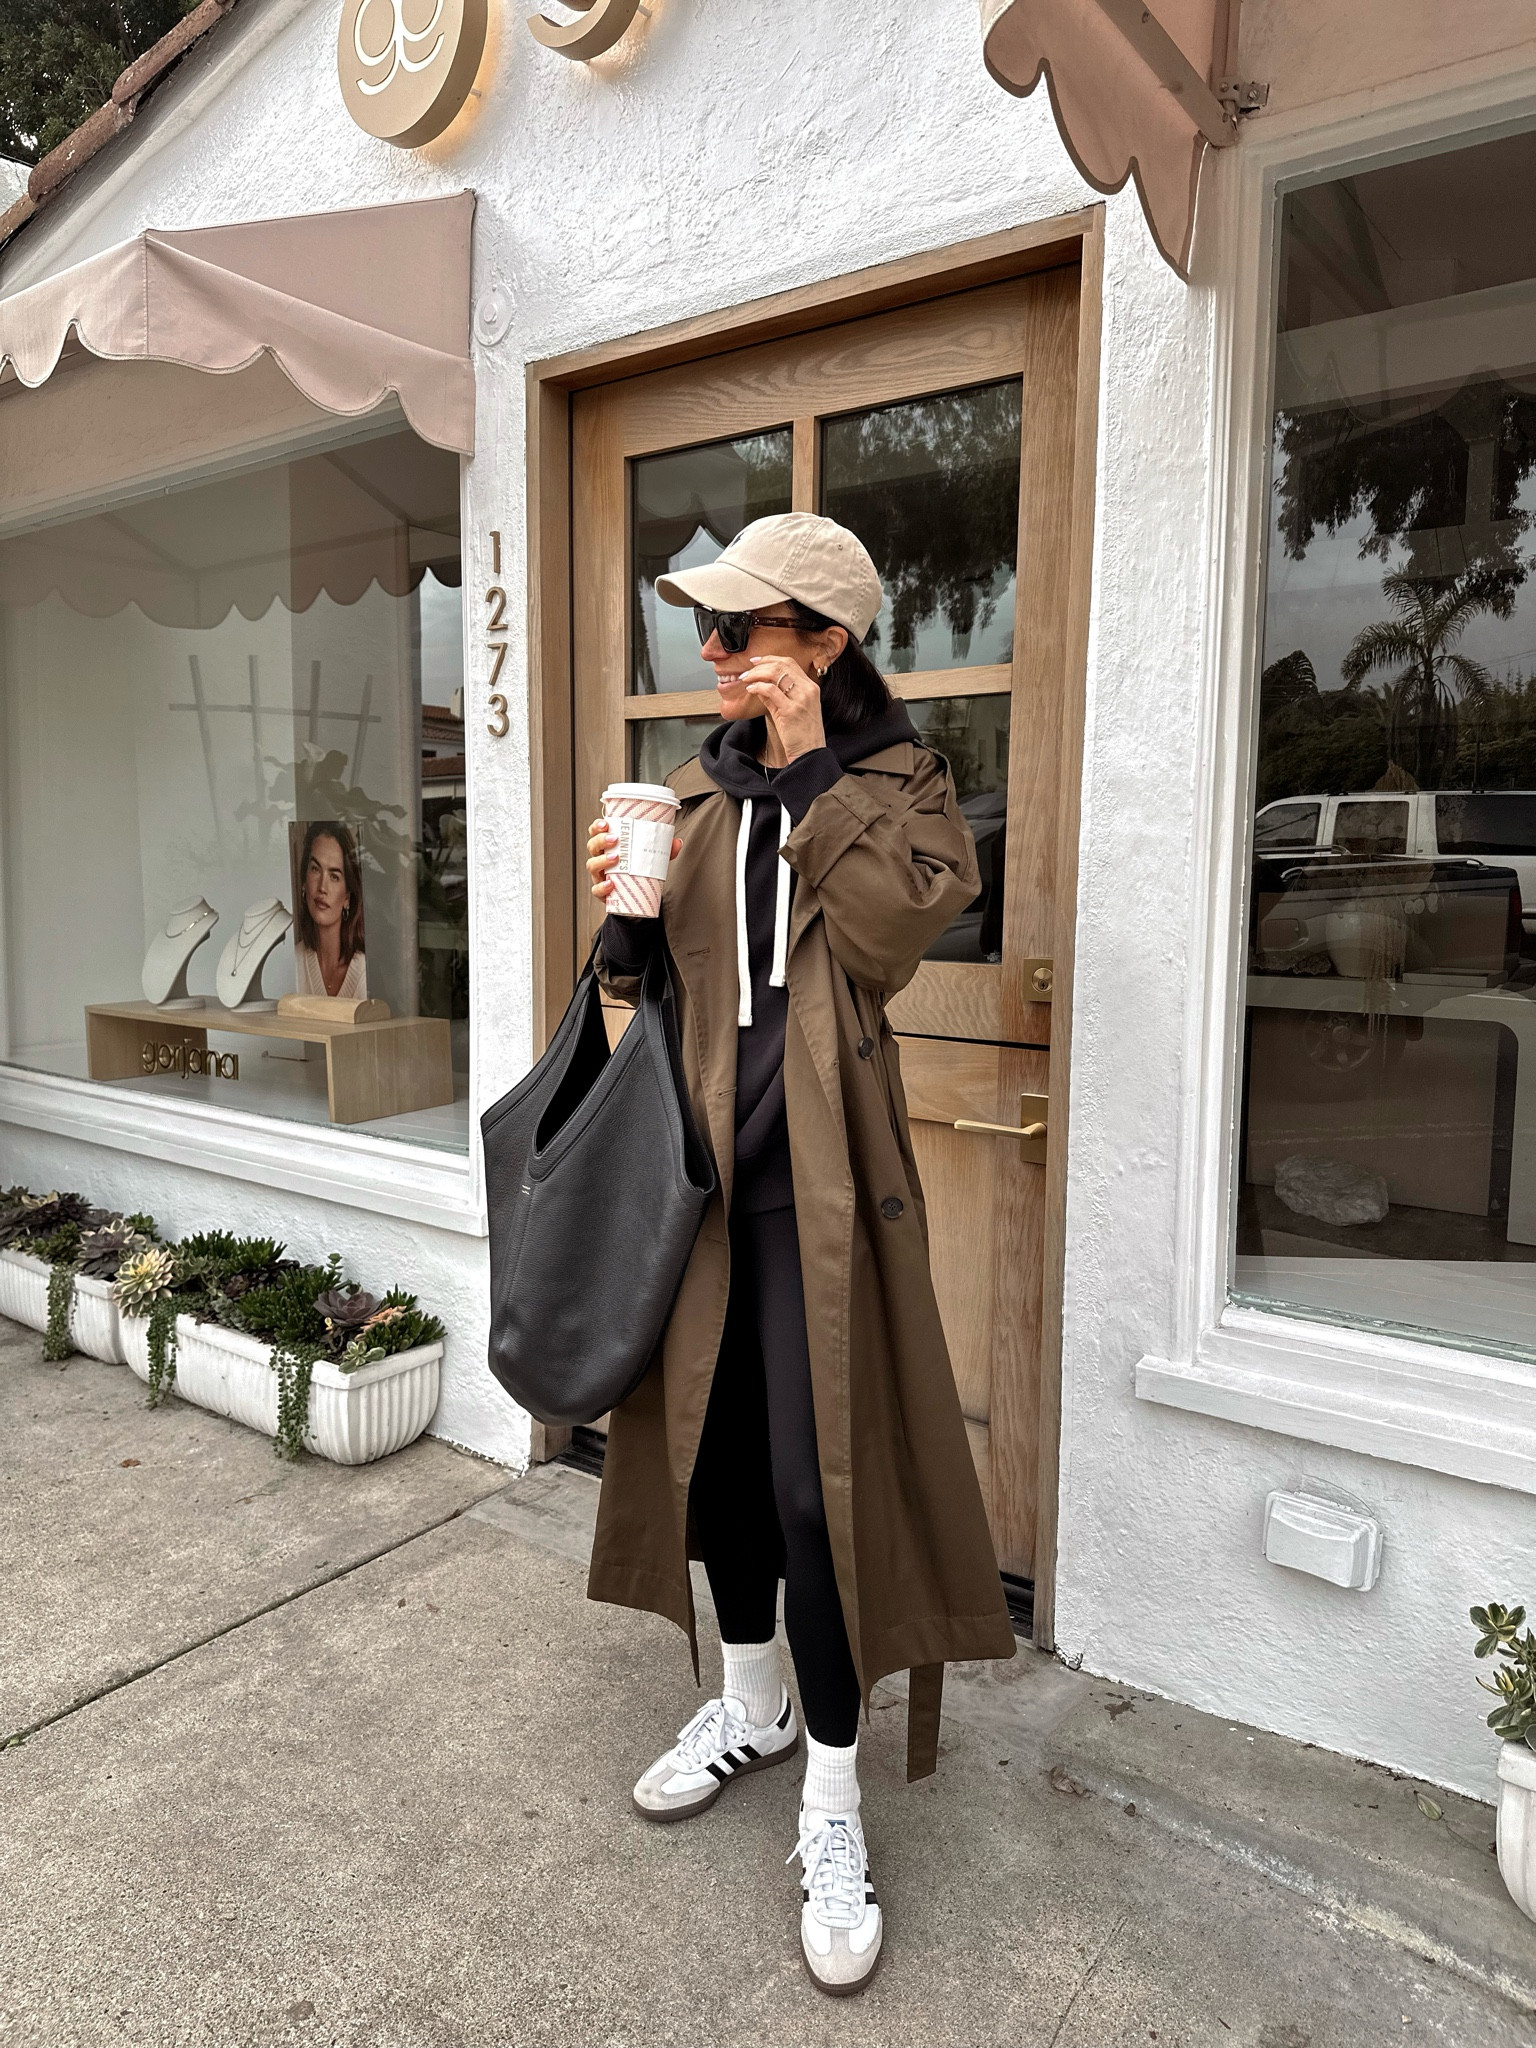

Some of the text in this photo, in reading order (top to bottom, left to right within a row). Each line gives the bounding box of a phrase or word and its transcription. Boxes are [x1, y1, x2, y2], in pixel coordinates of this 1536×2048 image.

[485, 531, 510, 737] 1273
[619, 820, 630, 871] JEANNINE'S
[142, 1038, 239, 1080] gorjana
